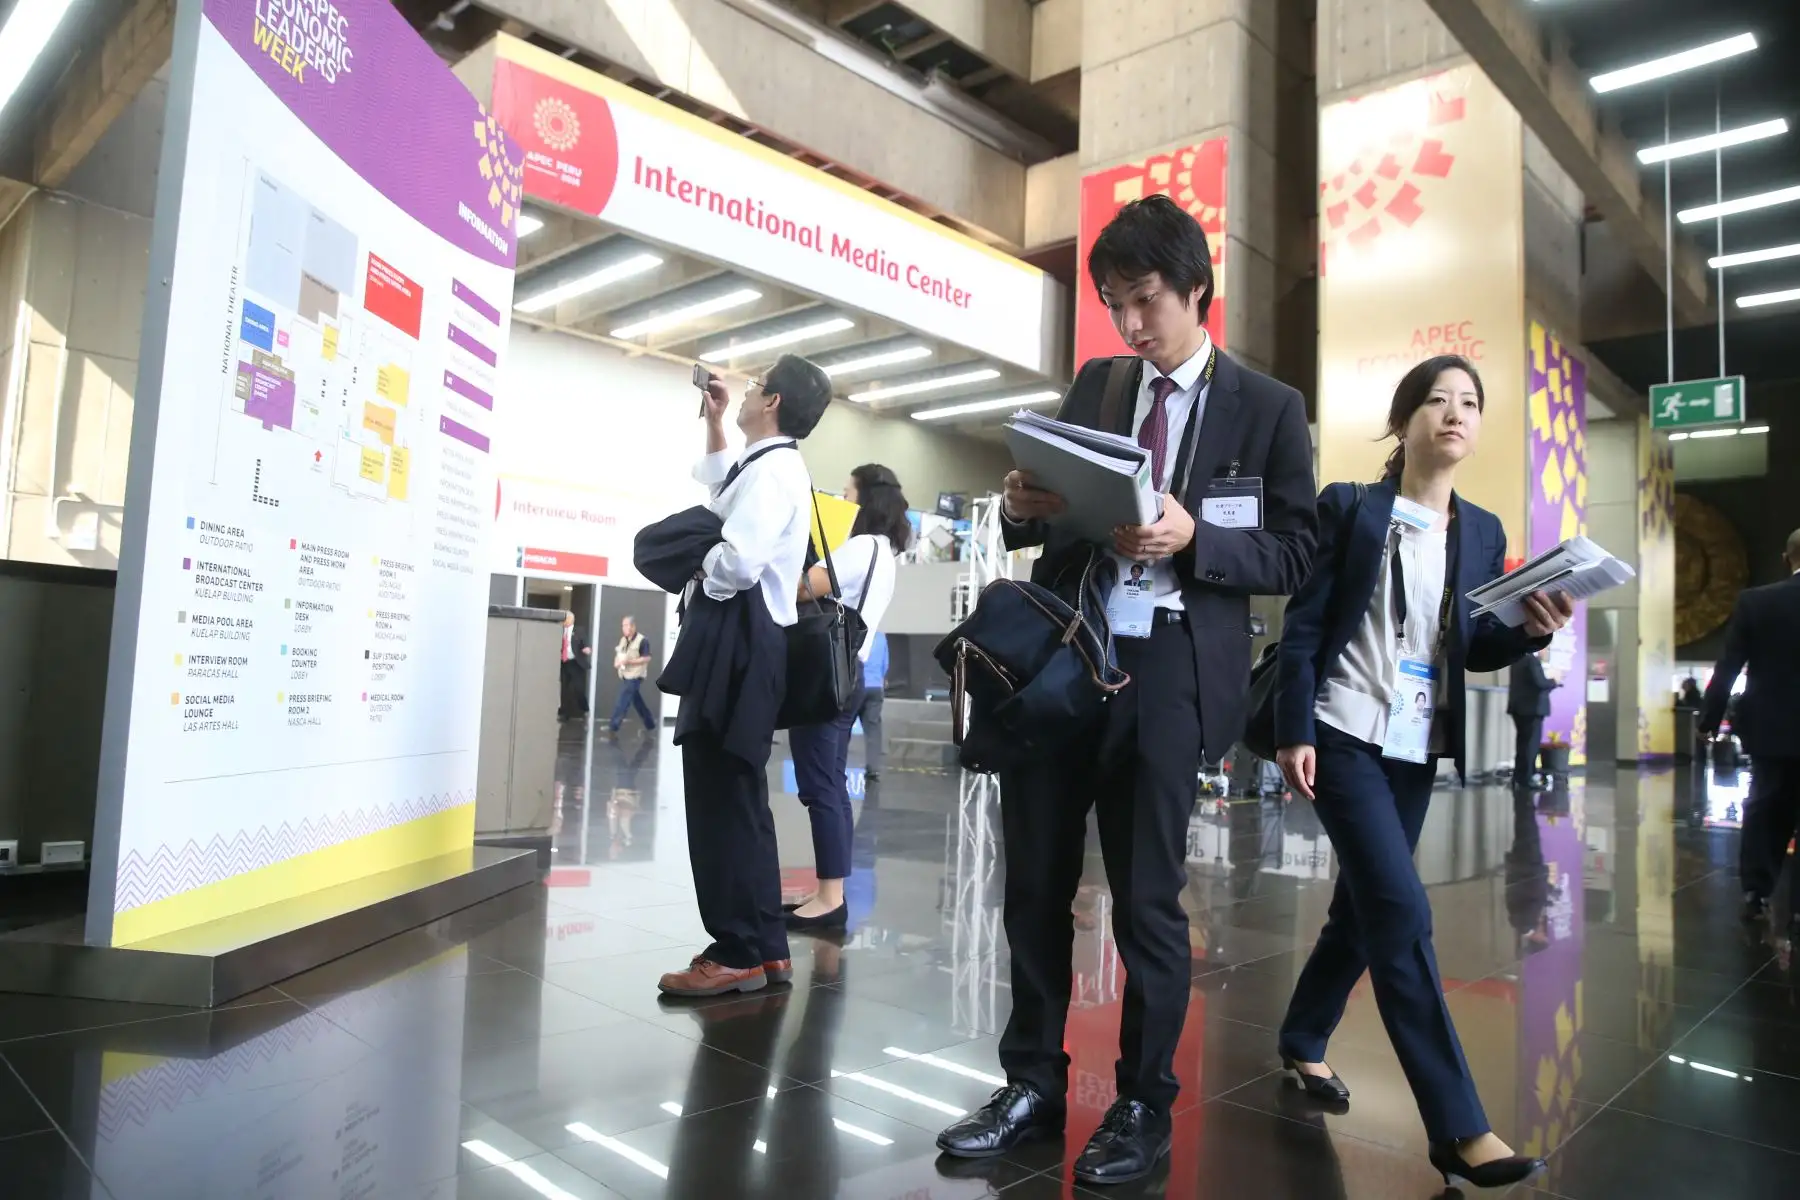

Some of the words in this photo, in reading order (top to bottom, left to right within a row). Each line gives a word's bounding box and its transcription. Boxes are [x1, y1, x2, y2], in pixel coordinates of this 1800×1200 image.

[270, 0, 354, 73] ONOMIC
[254, 17, 308, 84] WEEK
[458, 200, 508, 257] INFORMATION
[633, 155, 823, 253] International
[831, 233, 899, 282] Media
[906, 264, 972, 309] Center
[227, 265, 239, 319] THEATER
[1411, 320, 1473, 348] APEC
[221, 320, 234, 374] NATIONAL
[513, 500, 577, 520] Interview
[581, 510, 617, 526] Room
[200, 520, 225, 534] DINING
[227, 526, 245, 538] AREA
[199, 534, 234, 548] OUTDOOR
[234, 540, 254, 553] PATIO
[301, 541, 316, 553] MAIN
[317, 545, 334, 557] PRESS
[334, 549, 350, 559] ROOM
[196, 560, 251, 578] INTERNATIONAL
[300, 554, 312, 564] AND
[313, 556, 330, 567] PRESS
[330, 560, 346, 570] WORK
[299, 565, 314, 575] AREA
[195, 574, 237, 588] BROADCAST
[238, 580, 264, 592] CENTER
[195, 588, 222, 600] KUELAP
[222, 590, 254, 603] BUILDING
[295, 600, 334, 613] INFORMATION
[191, 614, 215, 625] MEDIA
[216, 616, 235, 627] POOL
[236, 618, 254, 629] AREA
[294, 611, 310, 621] DESK
[190, 627, 219, 639] KUELAP
[220, 629, 251, 641] BUILDING
[292, 647, 318, 657] BOOKING
[188, 655, 226, 665] INTERVIEW
[228, 656, 248, 666] ROOM
[291, 659, 318, 668] COUNTER
[187, 667, 221, 679] PARACAS
[221, 669, 239, 679] HALL
[185, 695, 212, 705] SOCIAL
[212, 695, 235, 704] MEDIA
[288, 694, 307, 703] PRESS
[307, 694, 332, 703] BRIEFING
[184, 708, 214, 718] LOUNGE
[288, 706, 305, 715] ROOM
[183, 722, 198, 732] LAS
[198, 720, 221, 731] ARTES
[222, 720, 240, 731] HALL
